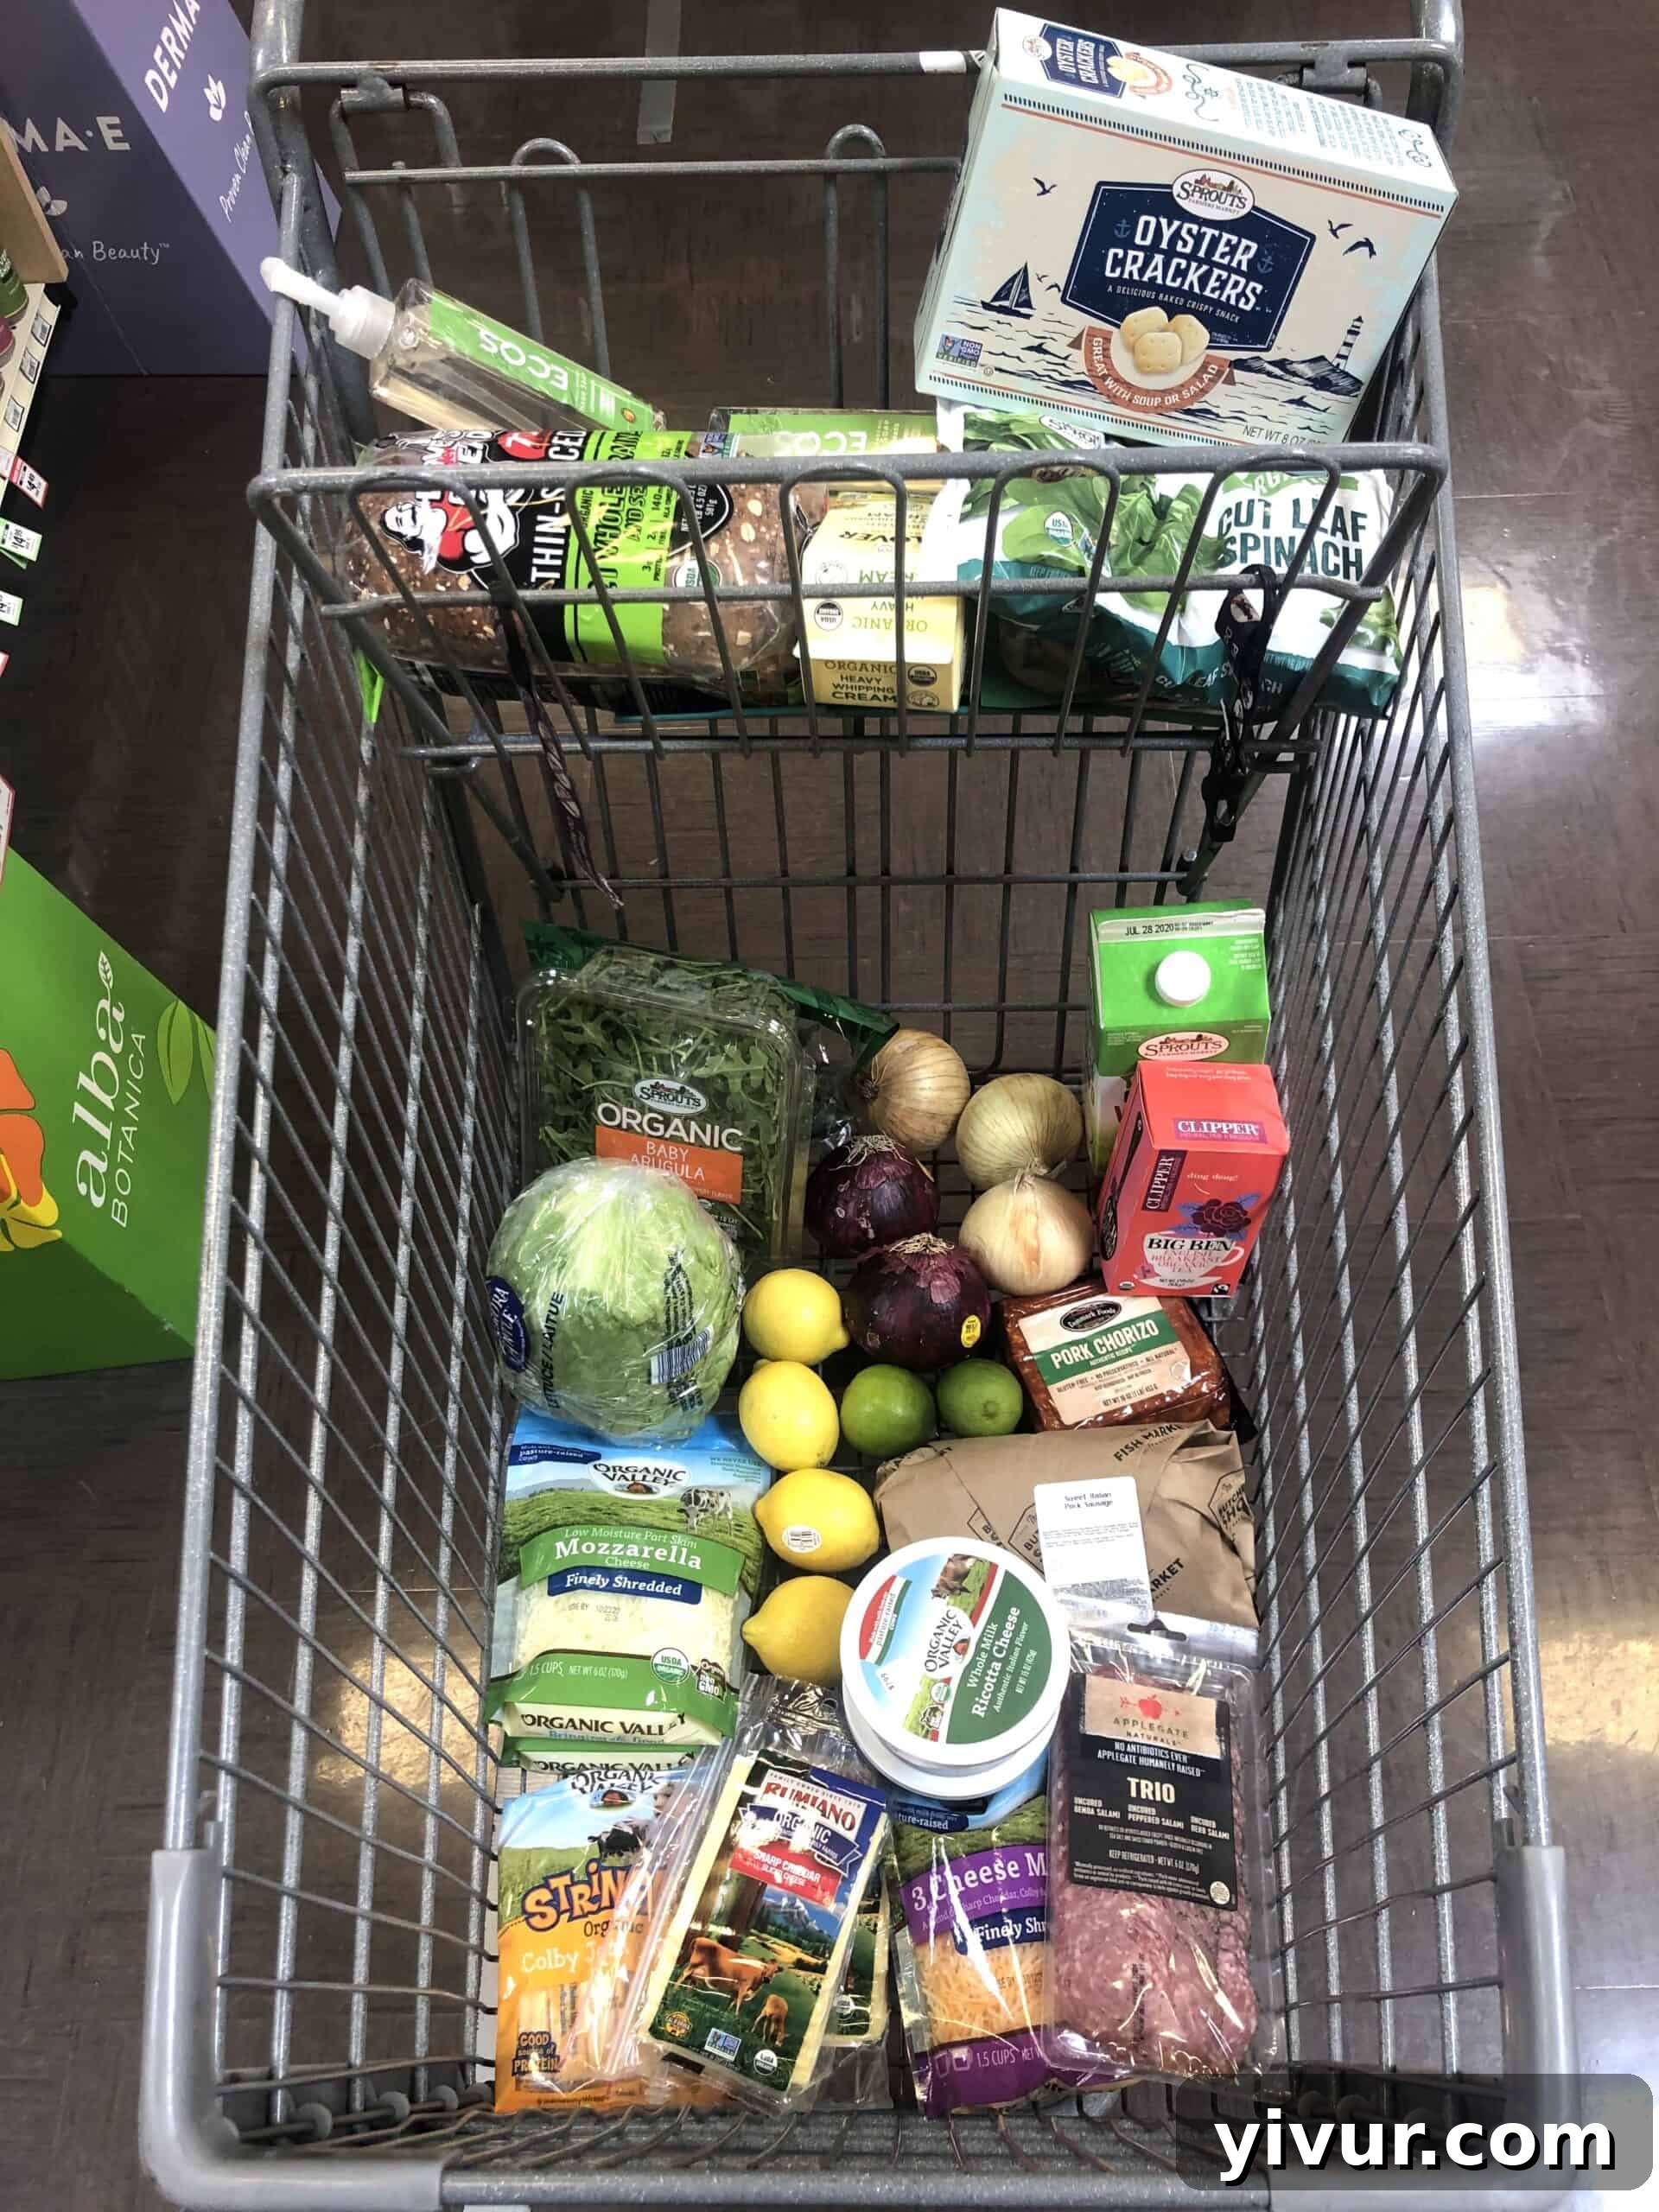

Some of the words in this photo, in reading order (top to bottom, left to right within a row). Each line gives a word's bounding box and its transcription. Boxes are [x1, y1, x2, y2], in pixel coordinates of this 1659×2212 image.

[1057, 38, 1076, 75] OYSTER
[1077, 38, 1096, 86] CRACKERS
[1176, 181, 1248, 211] SPROUTS
[1134, 214, 1258, 273] OYSTER
[1104, 247, 1265, 312] CRACKERS
[1107, 284, 1113, 293] A
[1116, 285, 1156, 300] DELICIOUS
[1158, 292, 1184, 306] BAKED
[1186, 298, 1214, 315] CRISPY
[1215, 308, 1241, 324] SNACK
[960, 346, 980, 356] GMO
[962, 340, 982, 350] NON
[478, 327, 569, 391] ECOS
[1091, 336, 1109, 378] GREAT
[1103, 377, 1131, 402] WITH
[1131, 394, 1162, 408] SOUP
[1164, 392, 1180, 406] OR
[1181, 363, 1219, 400] SALAD
[1243, 424, 1264, 439] NET
[1264, 427, 1281, 442] WT
[1281, 433, 1288, 444] 8
[1218, 498, 1272, 540] CUT
[1219, 531, 1363, 582] SPINACH
[870, 601, 915, 613] HAVY
[851, 615, 929, 632] ORANIC
[831, 683, 895, 694] WHIPPING
[839, 674, 883, 684] HEAVY
[830, 691, 899, 704] CREAM
[1125, 925, 1140, 936] JUL
[1141, 925, 1154, 934] 28
[1155, 923, 1175, 933] 2020
[1144, 1039, 1224, 1057] SPROUTS
[72, 997, 126, 1210] alba
[639, 1086, 702, 1109] SPROUTS
[111, 1032, 147, 1229] BOTANICA
[596, 1102, 744, 1153] ORGANIC
[1177, 1120, 1260, 1136] CLIPPER
[646, 1140, 690, 1160] BABY
[630, 1153, 706, 1183] ARUGULA
[1146, 1155, 1176, 1209] CLIPPER
[1147, 1237, 1186, 1251] BIG
[1188, 1239, 1234, 1252] BEN
[1050, 1344, 1095, 1370] PORK
[1093, 1319, 1160, 1356] CHORIZO
[1113, 1438, 1143, 1462] FISH
[593, 1461, 687, 1482] ORGANIC
[601, 1471, 678, 1488] VALLEY
[564, 1526, 588, 1540] Low
[591, 1527, 642, 1541] Moisture
[644, 1529, 668, 1544] Part
[670, 1534, 698, 1550] Skim
[554, 1538, 702, 1571] Mozzarella
[604, 1555, 651, 1571] Cheese
[565, 1573, 611, 1589] Finely
[613, 1575, 683, 1597] Shredded
[924, 1609, 958, 1673] ORGANIC
[938, 1619, 964, 1670] VALLEY
[661, 1655, 683, 1667] USDA
[966, 1649, 989, 1688] Whole
[981, 1622, 999, 1649] Milk
[970, 1660, 1002, 1719] Ricotta
[992, 1606, 1020, 1659] Cheese
[541, 1661, 564, 1677] CUPS
[569, 1664, 582, 1675] NET
[582, 1665, 593, 1676] WT
[598, 1668, 607, 1678] OZ
[993, 1673, 1014, 1713] Authentic
[1007, 1643, 1021, 1675] Italian
[521, 1713, 615, 1734] ORGANIC
[1113, 1716, 1190, 1739] APPLEGATE
[1097, 1750, 1138, 1765] APPLEGATE
[1138, 1756, 1177, 1772] HUMANELY
[1114, 1741, 1126, 1751] NO
[1126, 1743, 1170, 1760] ANTIBIOTICS
[1127, 1777, 1176, 1804] TRIO
[1096, 1808, 1121, 1820] SALAMI
[1161, 1818, 1185, 1830] SALAMI
[1207, 1827, 1230, 1840] SALAMI
[912, 1885, 927, 1911] 3
[520, 1948, 579, 1975] Colby
[519, 2033, 550, 2047] GOOD
[990, 2047, 1015, 2067] CUPS
